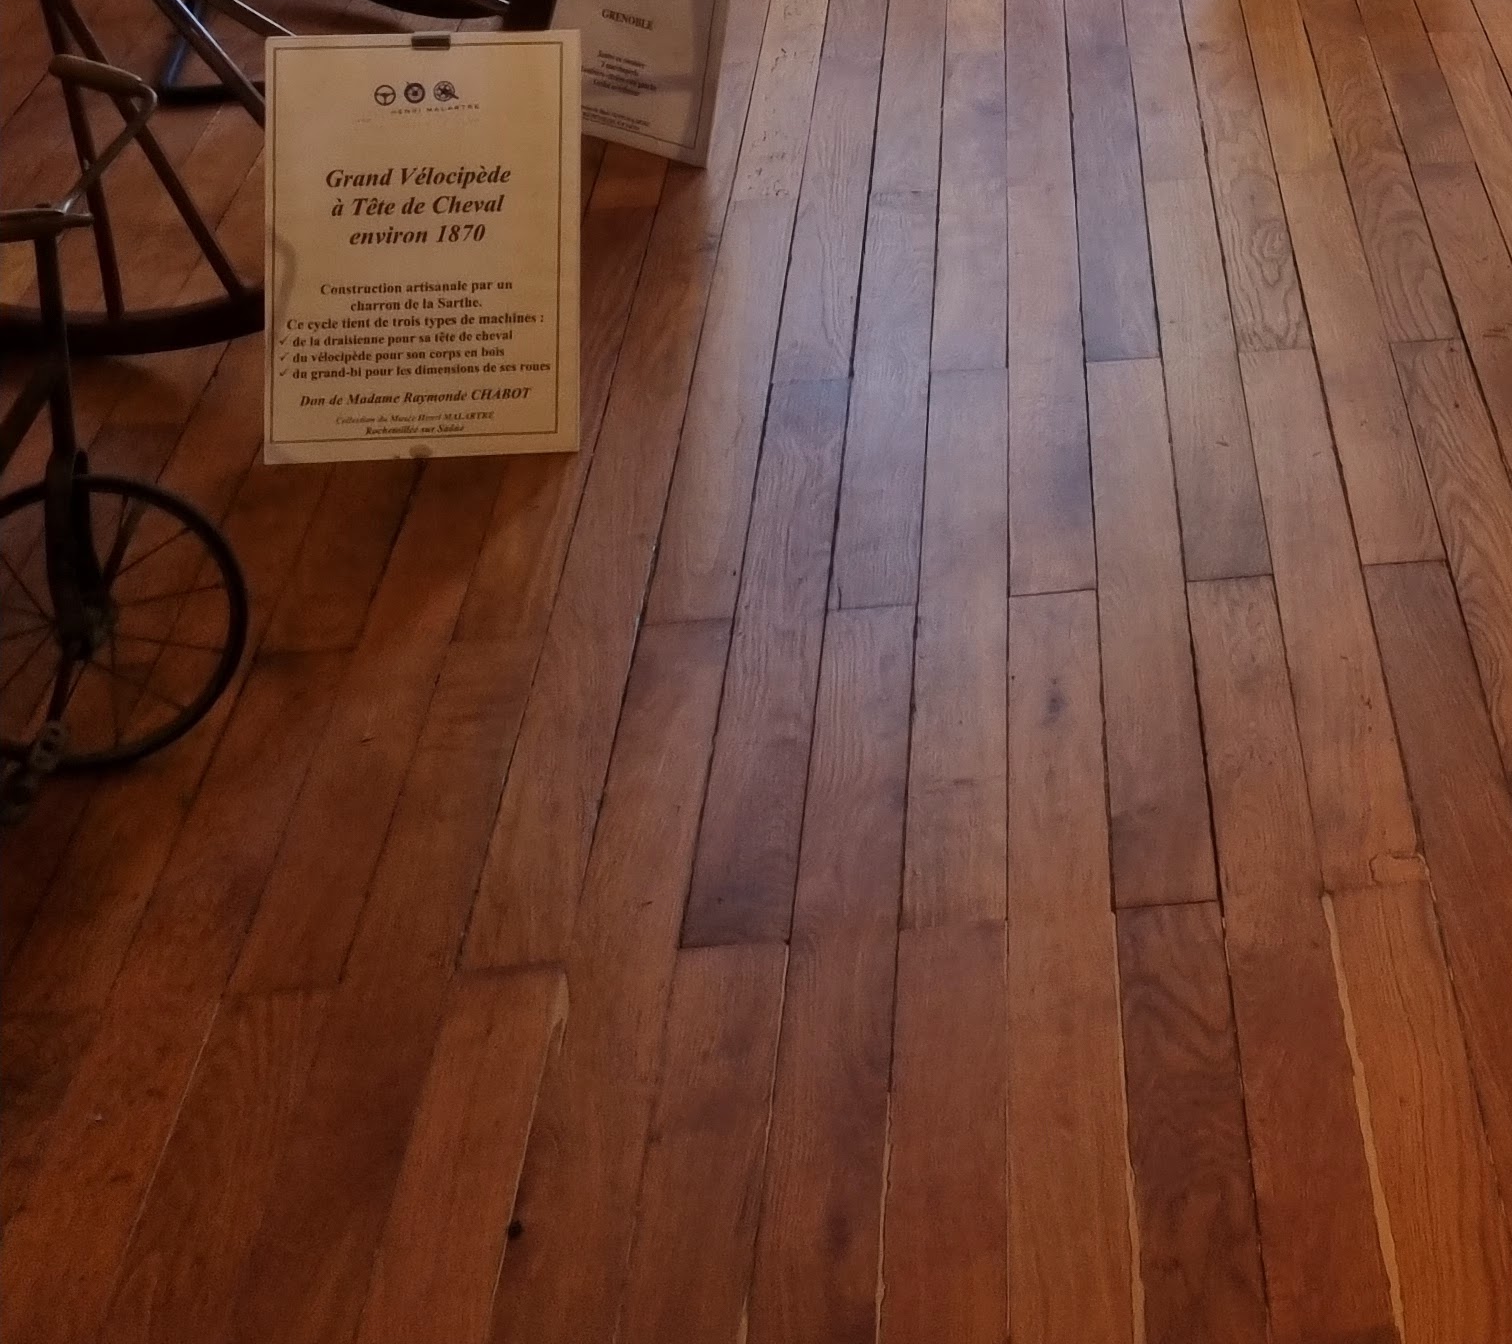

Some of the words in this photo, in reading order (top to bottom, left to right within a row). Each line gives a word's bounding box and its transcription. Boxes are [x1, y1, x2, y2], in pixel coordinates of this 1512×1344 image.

[601, 9, 654, 30] GRENOBLE
[325, 167, 394, 188] Grand
[399, 164, 512, 189] Vélocipède
[331, 198, 344, 217] à
[352, 198, 395, 216] Tête
[401, 197, 426, 215] de
[432, 194, 505, 214] Cheval
[349, 226, 428, 246] environ
[436, 223, 486, 243] 1870
[320, 283, 402, 295] Construction
[406, 281, 468, 292] artisanale
[471, 281, 493, 293] par
[497, 281, 513, 290] un
[350, 300, 401, 312] charron
[404, 299, 419, 310] de
[422, 298, 434, 309] la
[438, 297, 482, 309] Sarthe.
[286, 319, 304, 330] Ce
[307, 318, 338, 332] cycle
[341, 317, 370, 329] tient
[374, 317, 388, 327] de
[392, 316, 421, 327] trois
[424, 317, 457, 329] types
[460, 314, 475, 325] de
[479, 313, 537, 325] machines
[292, 337, 306, 347] de
[310, 336, 320, 346] la
[323, 335, 385, 346] draisienne
[387, 335, 416, 347] pour
[419, 334, 431, 343] sa
[434, 332, 456, 343] tête
[459, 331, 472, 342] de
[475, 330, 513, 341] cheval
[292, 353, 308, 363] du
[312, 351, 372, 364] vélocipède
[375, 352, 404, 363] pour
[406, 351, 426, 359] son
[429, 349, 461, 361] corps
[464, 349, 478, 357] en
[481, 347, 505, 357] bois
[292, 369, 307, 379] du
[310, 367, 362, 381] grand-bi
[365, 368, 394, 379] pour
[397, 366, 411, 376] les
[414, 364, 480, 375] dimensions
[483, 363, 496, 372] de
[500, 363, 516, 372] ses
[520, 363, 551, 371] roues
[300, 395, 326, 406] Don
[329, 394, 343, 406] de
[349, 393, 400, 405] Madame
[403, 391, 467, 405] Raymonde
[470, 387, 532, 400] CHABOT
